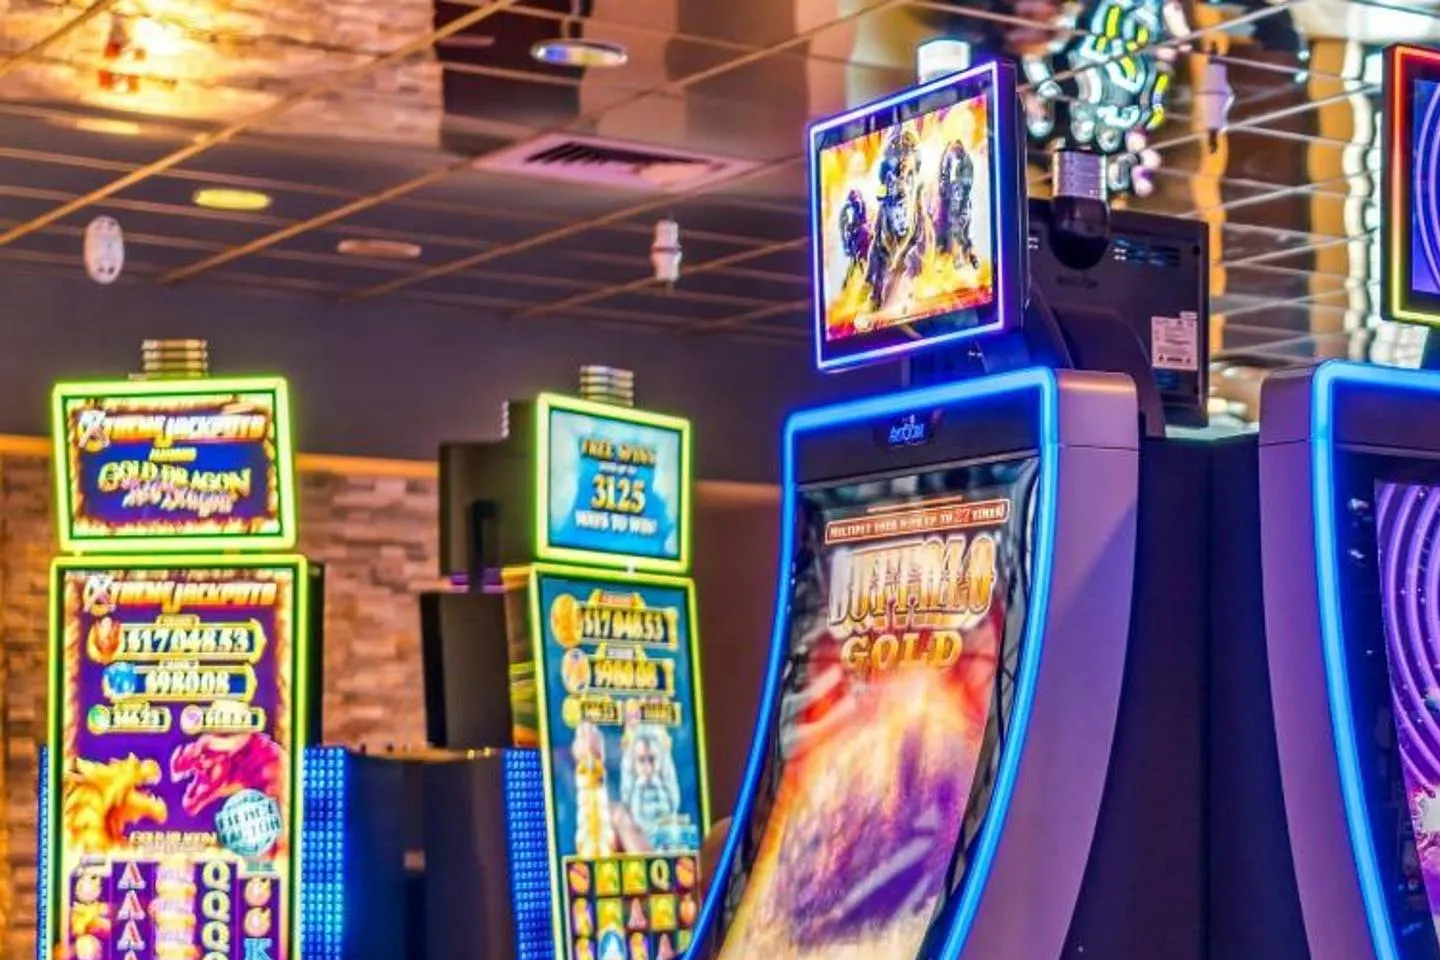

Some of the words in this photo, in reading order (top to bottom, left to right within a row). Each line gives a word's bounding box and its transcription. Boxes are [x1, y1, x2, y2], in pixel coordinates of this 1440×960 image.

[98, 461, 158, 491] GOLD
[160, 464, 252, 496] DRAGON
[591, 474, 646, 514] 3125
[829, 533, 996, 636] BUFFALO
[841, 631, 963, 671] GOLD
[202, 859, 230, 891] Q
[202, 890, 230, 922] Q
[202, 921, 230, 953] Q
